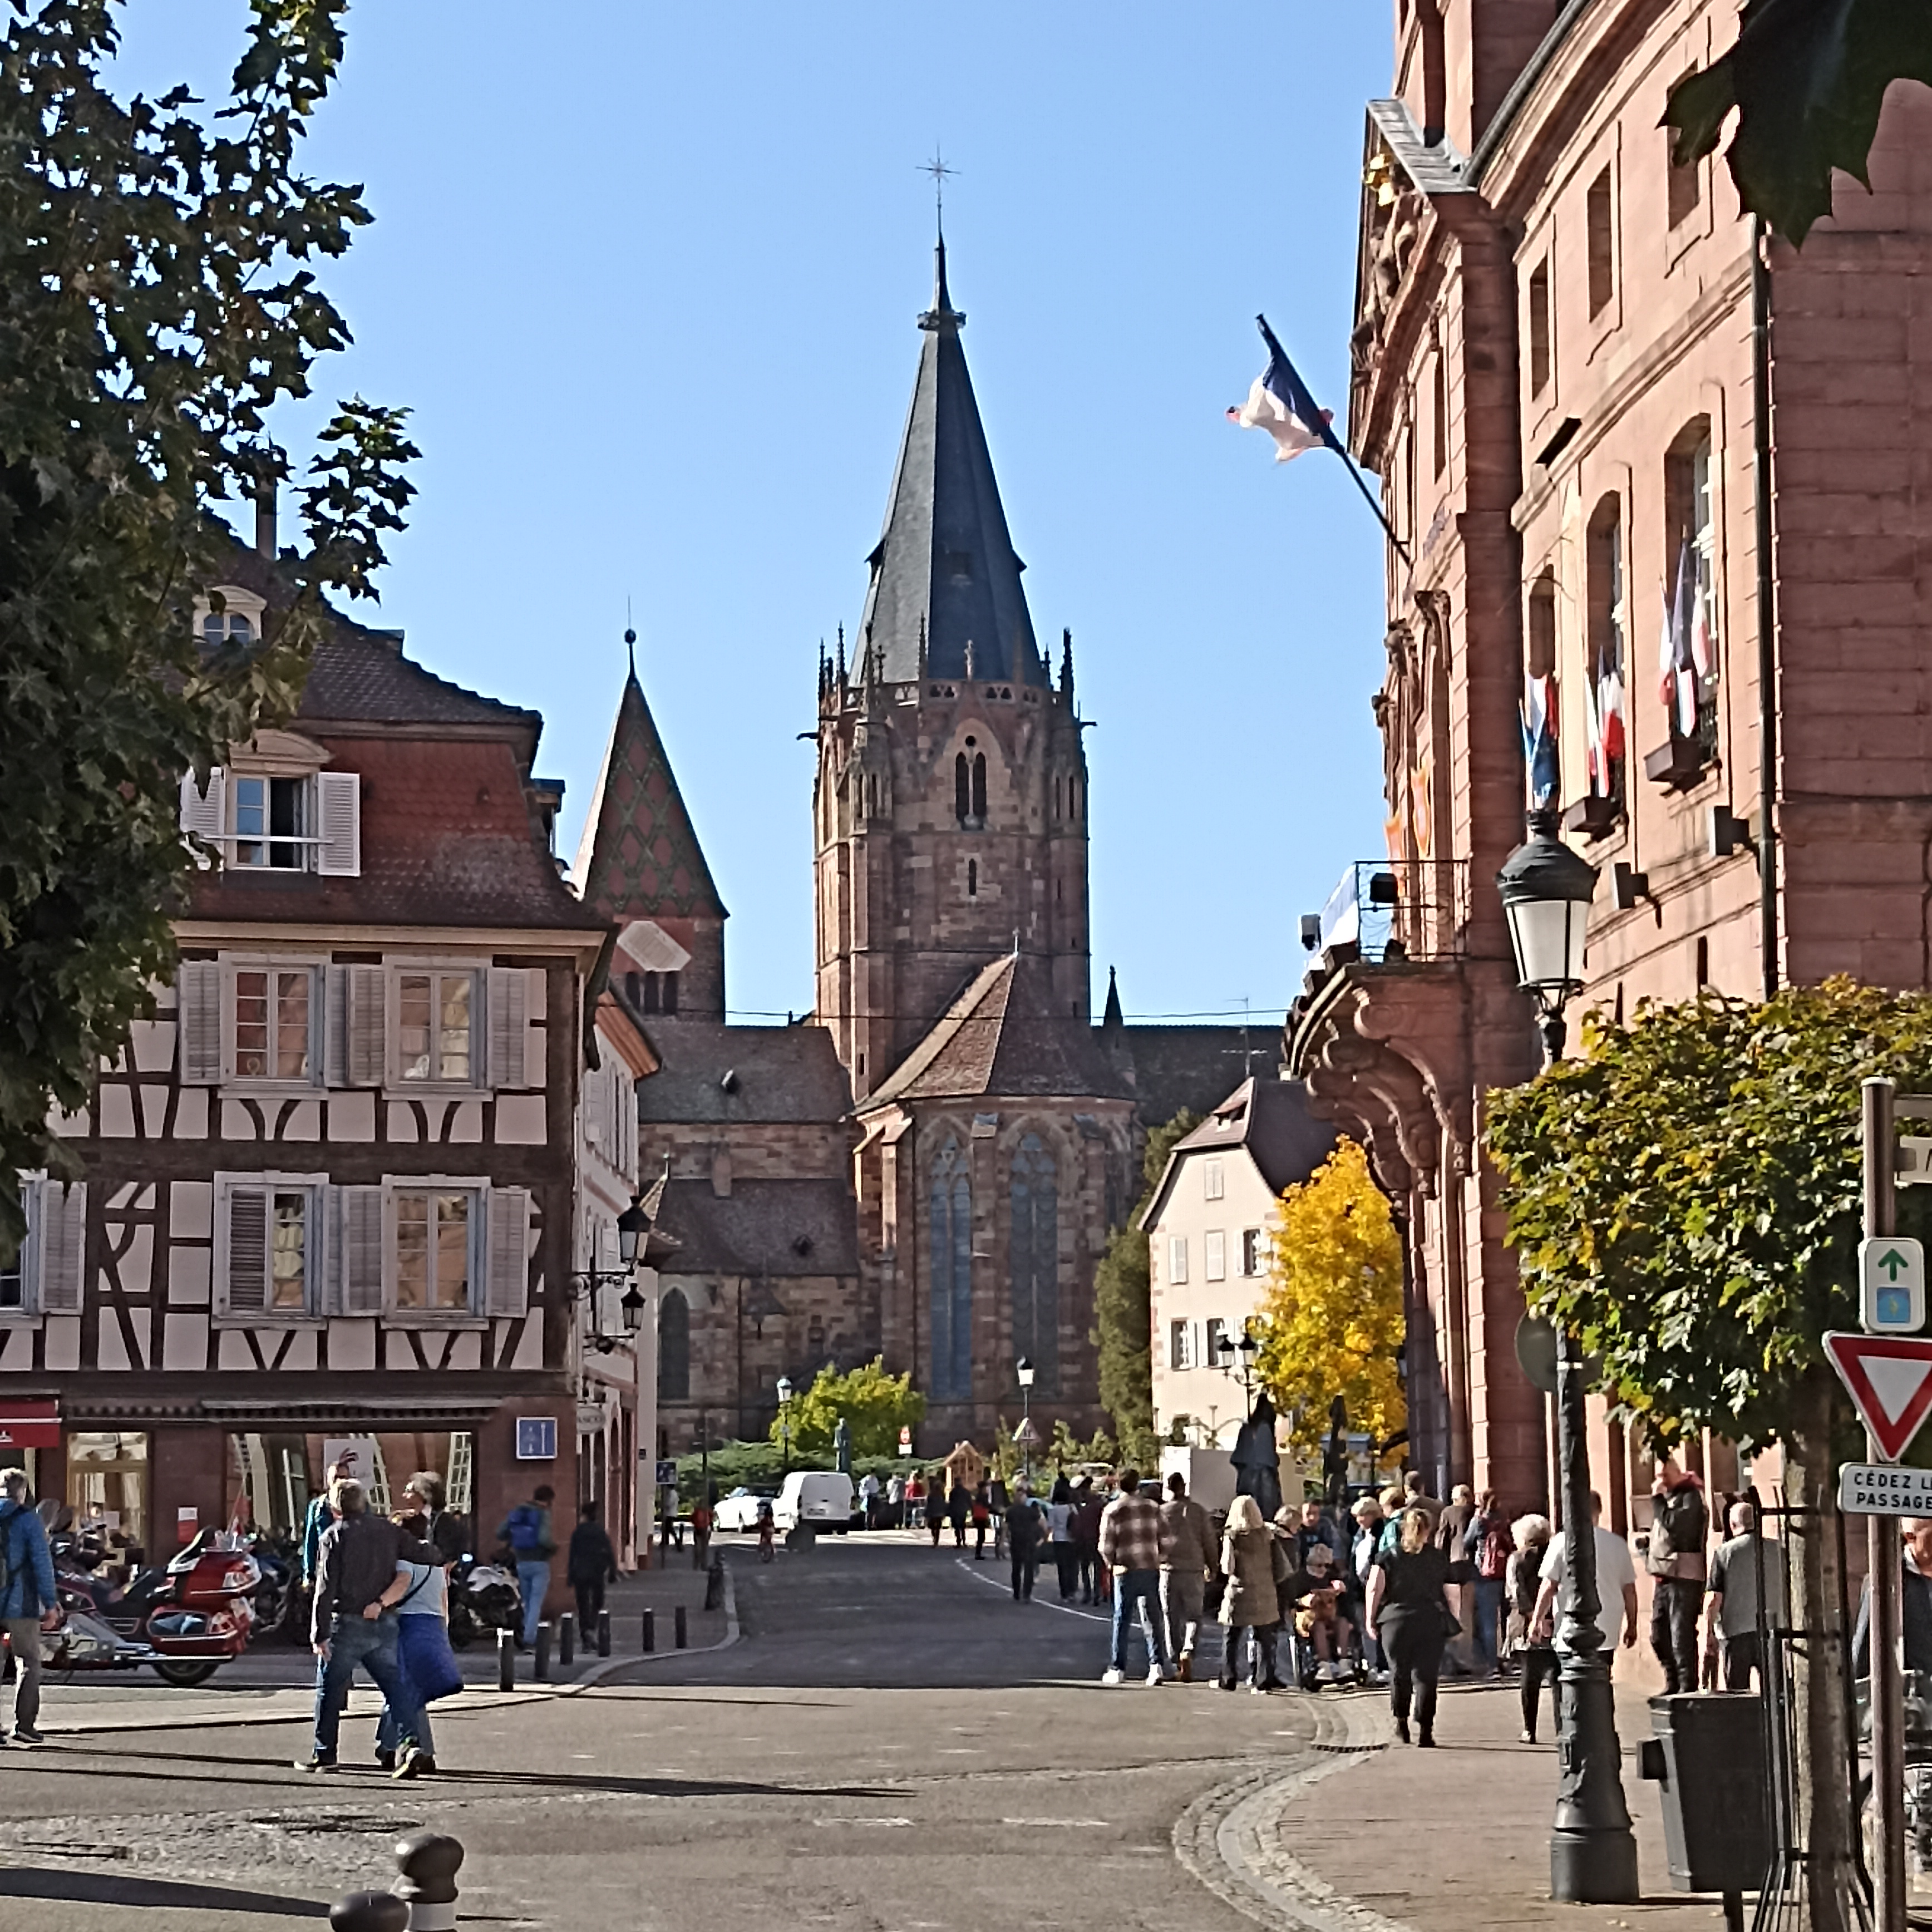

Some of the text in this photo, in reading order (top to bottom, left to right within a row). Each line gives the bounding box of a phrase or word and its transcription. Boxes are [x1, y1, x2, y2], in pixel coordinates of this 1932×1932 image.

[1854, 1470, 1932, 1490] CÉDEZ L
[1856, 1492, 1932, 1510] PASSAGE
